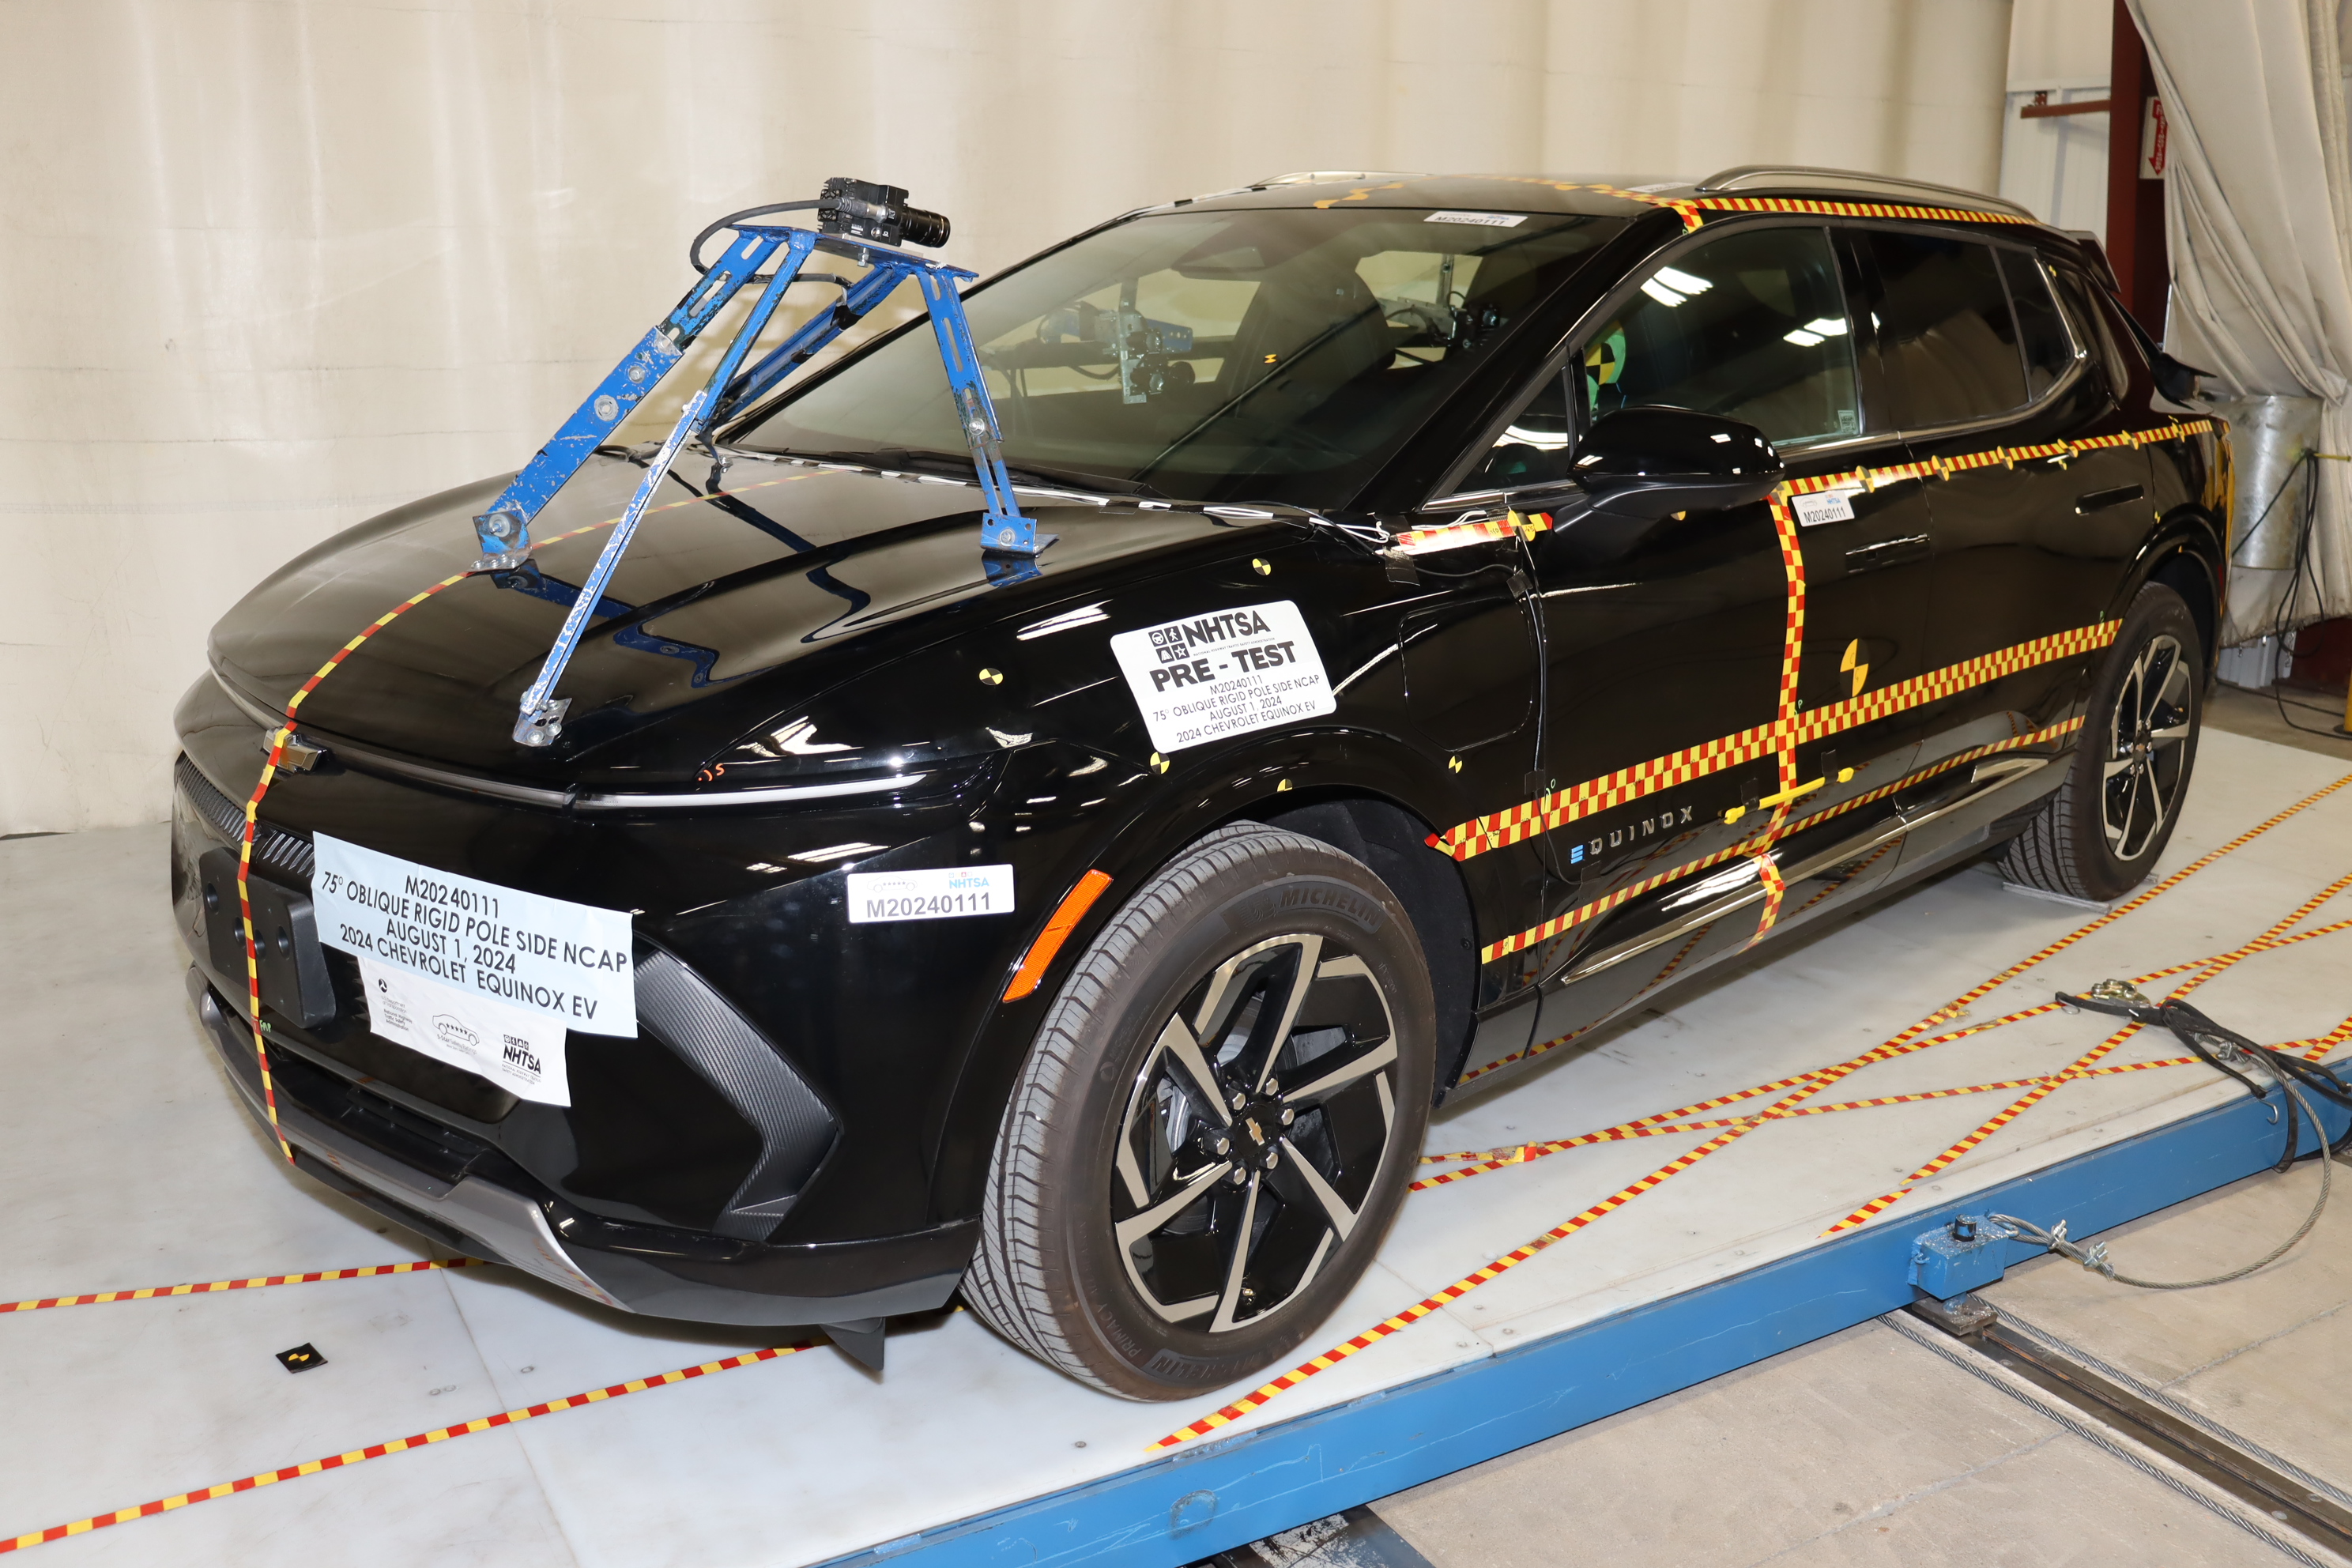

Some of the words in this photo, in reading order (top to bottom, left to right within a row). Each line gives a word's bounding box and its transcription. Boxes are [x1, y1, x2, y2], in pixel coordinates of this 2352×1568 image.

[1434, 217, 1505, 225] M20240111
[1804, 507, 1846, 523] M20240111
[1182, 610, 1271, 647] NHTSA
[1149, 658, 1216, 692] PRE
[1231, 641, 1296, 673] TEST
[1210, 675, 1263, 695] M20240111
[1173, 696, 1218, 718] OBLIQUE
[1219, 691, 1246, 708] RIGID
[1248, 684, 1272, 702] POLE
[1272, 680, 1293, 696] SIDE
[1294, 674, 1320, 692] NCAP
[1209, 703, 1246, 722] AUGUST
[1250, 700, 1260, 713] 1,
[1261, 695, 1283, 710] 2024
[1177, 729, 1202, 743] 2024
[1204, 712, 1260, 736] CHEVROLET
[1261, 703, 1304, 722] EQUINOX
[1304, 700, 1316, 712] EV
[1570, 806, 1693, 865] EQUINOX
[405, 875, 499, 918] M20240111
[949, 877, 989, 889] NHTSA
[866, 891, 989, 918] M20240111
[1280, 888, 1379, 927] MICHELIN
[347, 881, 409, 919] OBLIQUE
[414, 902, 459, 933] RIGID
[466, 917, 509, 948] POLE
[517, 930, 556, 960] SIDE
[564, 942, 628, 973] NCAP
[386, 918, 447, 954] AUGUST
[454, 938, 468, 962] 1,
[473, 944, 516, 974] 2024
[340, 924, 373, 952] 2024
[377, 939, 466, 984] CHEVROLET
[477, 969, 565, 1012] EQUINOX
[573, 996, 598, 1020] EV
[503, 1044, 541, 1075] NHTSA
[1098, 1302, 1142, 1358] PRIMACY
